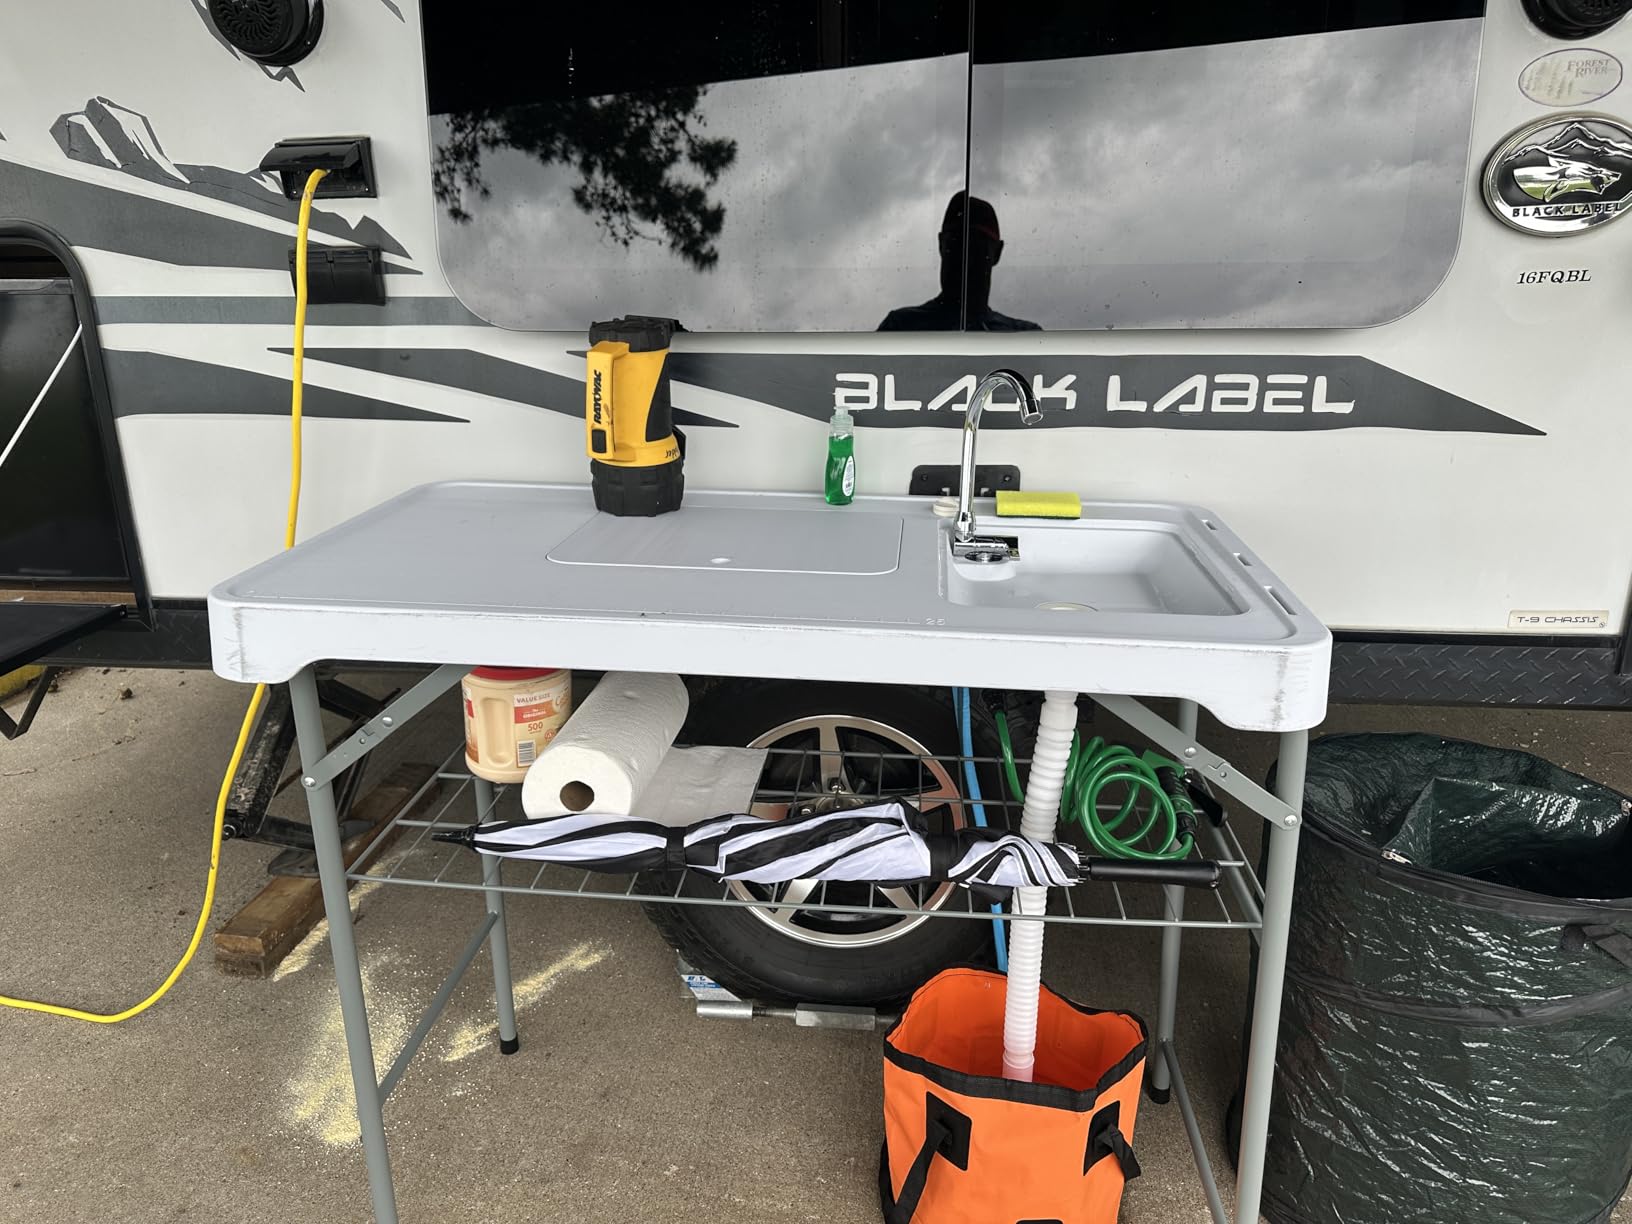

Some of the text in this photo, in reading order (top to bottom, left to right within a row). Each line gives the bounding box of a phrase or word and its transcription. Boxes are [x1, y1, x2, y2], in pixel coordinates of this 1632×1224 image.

[1567, 59, 1611, 72] FOREST
[1575, 67, 1608, 78] RIVER
[1512, 202, 1622, 217] BLACK LABEL
[1516, 269, 1592, 284] 16FQBL
[593, 370, 602, 424] RAYOVAC
[1106, 374, 1355, 414] LABEL
[516, 695, 538, 703] VALUE
[528, 721, 544, 731] 500
